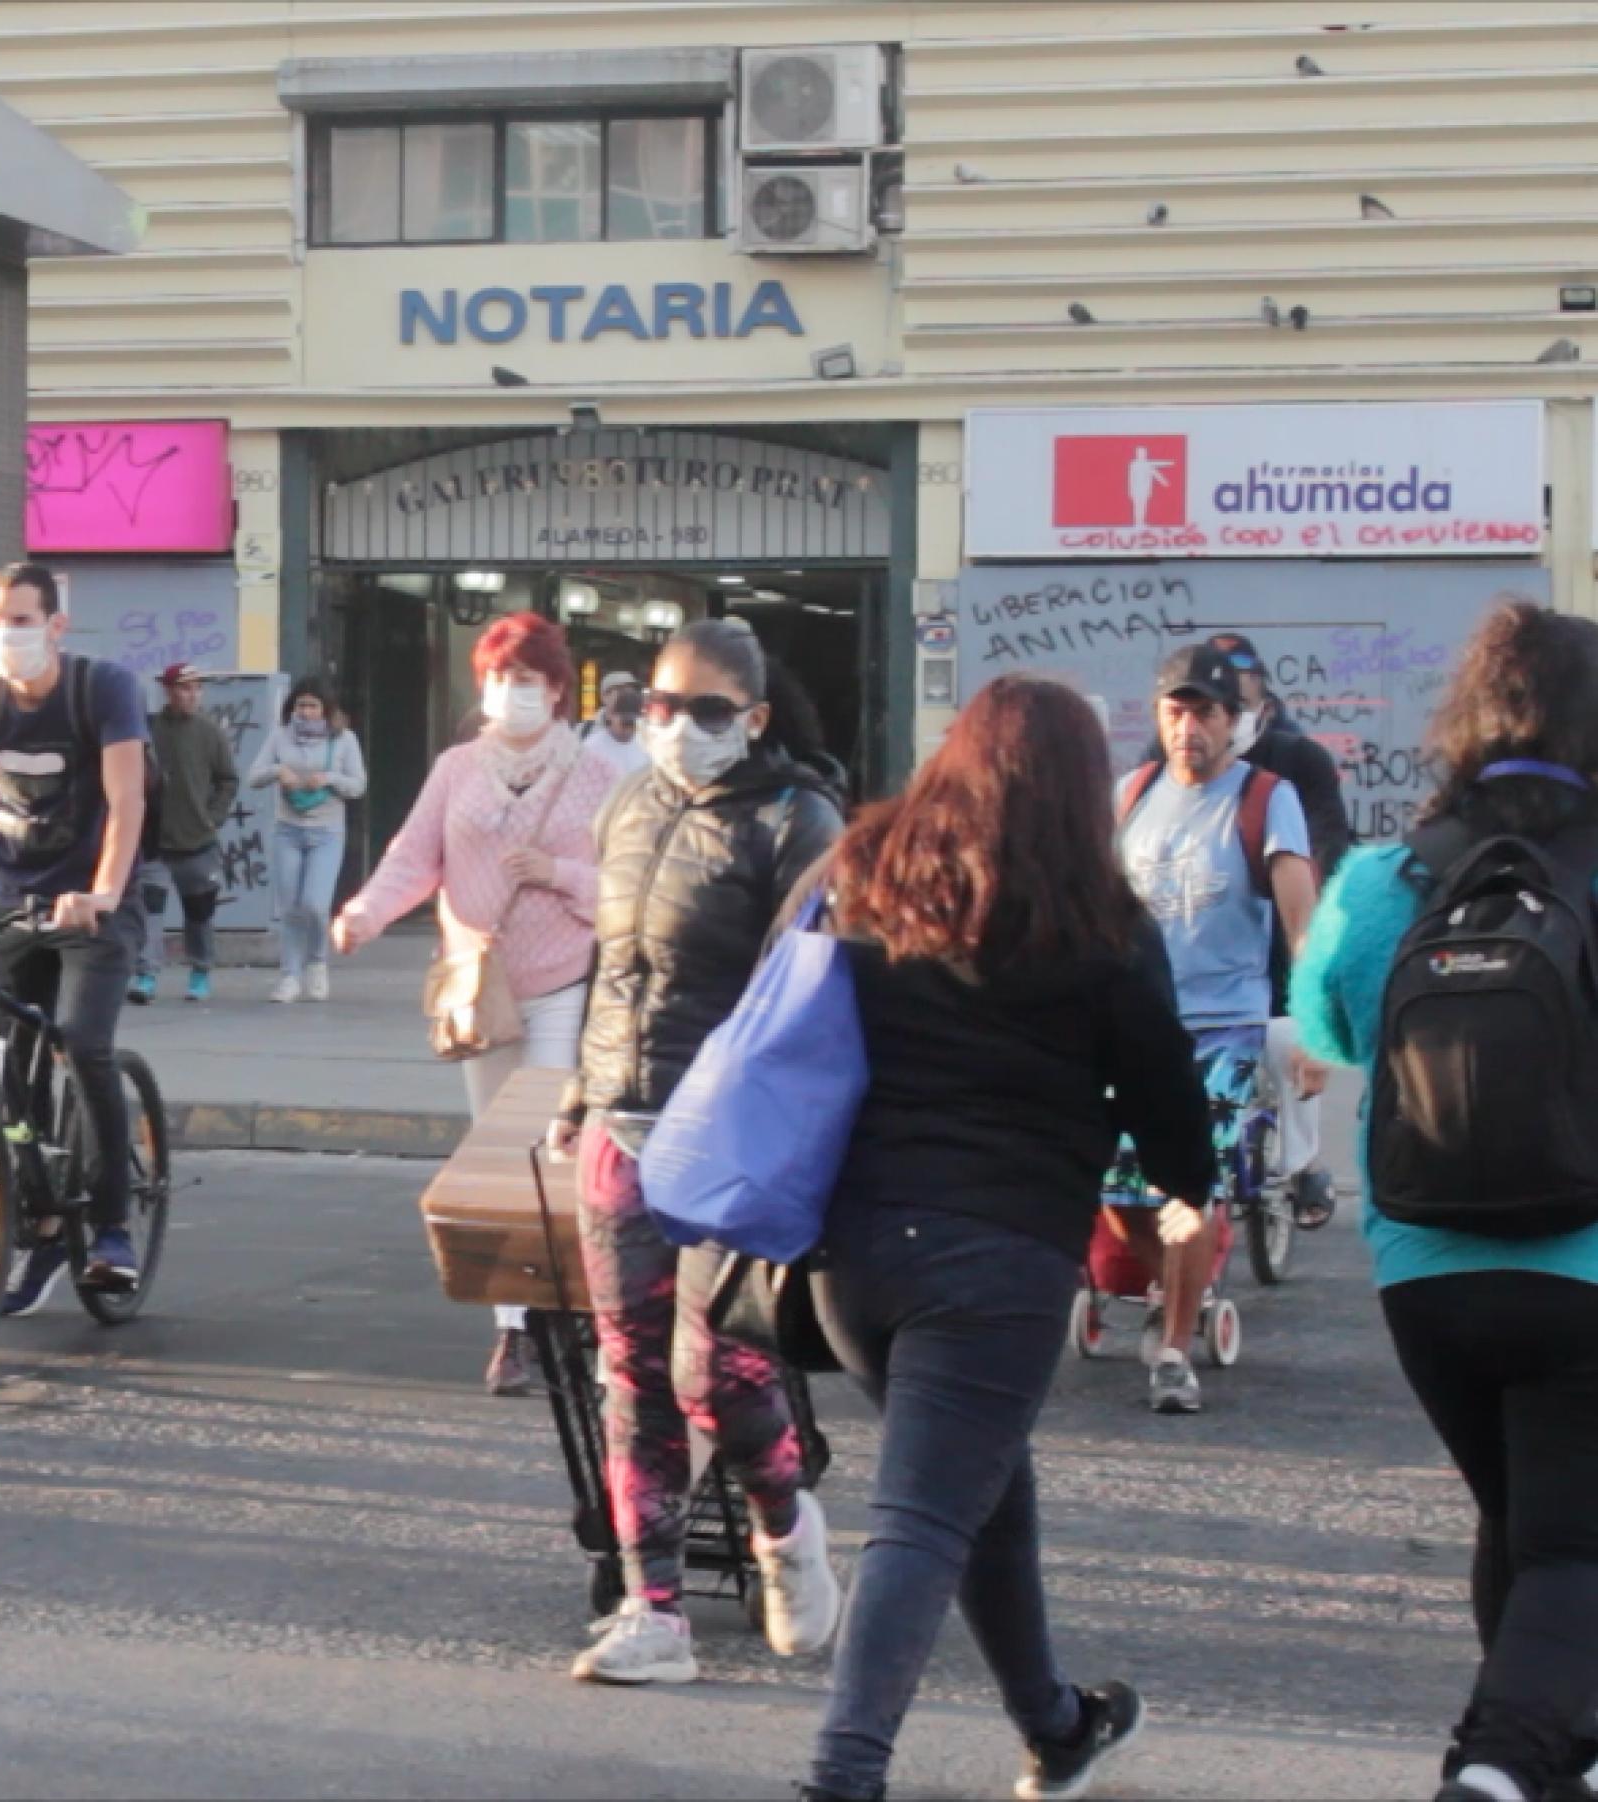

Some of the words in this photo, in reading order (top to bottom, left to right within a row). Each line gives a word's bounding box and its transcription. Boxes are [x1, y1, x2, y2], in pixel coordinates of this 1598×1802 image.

[400, 280, 804, 345] NOTARIA
[751, 463, 850, 509] PRAT
[1213, 466, 1451, 514] ahumada
[537, 527, 650, 545] ALAMEDA
[982, 606, 1197, 662] ANIMAL
